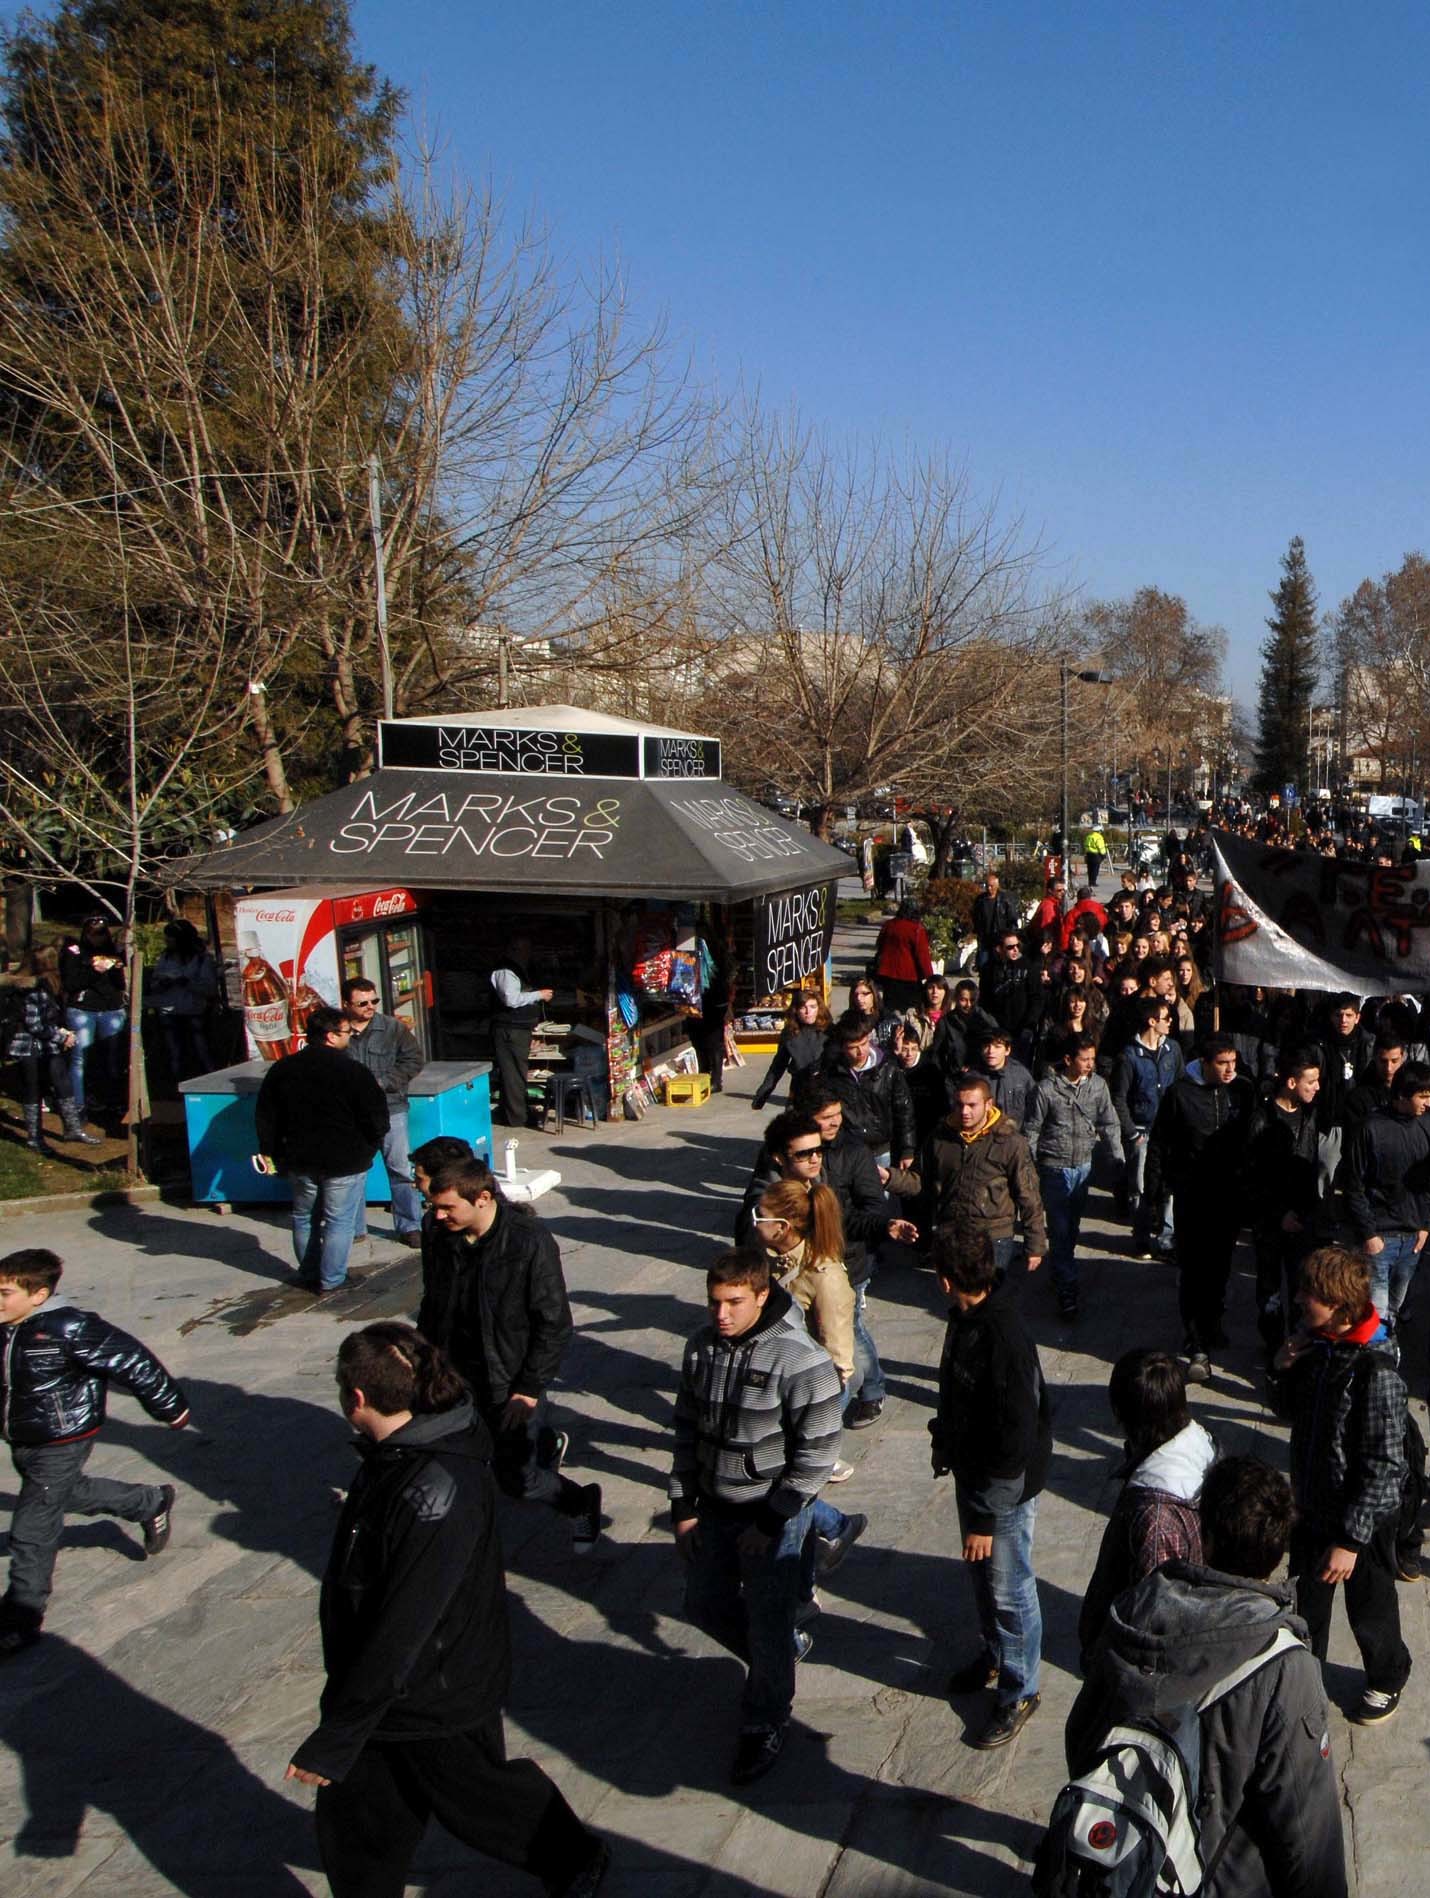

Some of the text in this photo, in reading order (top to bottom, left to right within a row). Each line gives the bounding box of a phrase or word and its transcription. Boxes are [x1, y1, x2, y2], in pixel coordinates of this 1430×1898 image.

[438, 728, 583, 754] MARKS &
[660, 739, 705, 758] MARKS &
[439, 750, 584, 775] SPENCER
[660, 759, 704, 777] SPENCER
[350, 791, 621, 827] MARKS &
[329, 823, 613, 859] SPENCER
[767, 887, 828, 945] MARKS &
[766, 930, 824, 994] SPENCER
